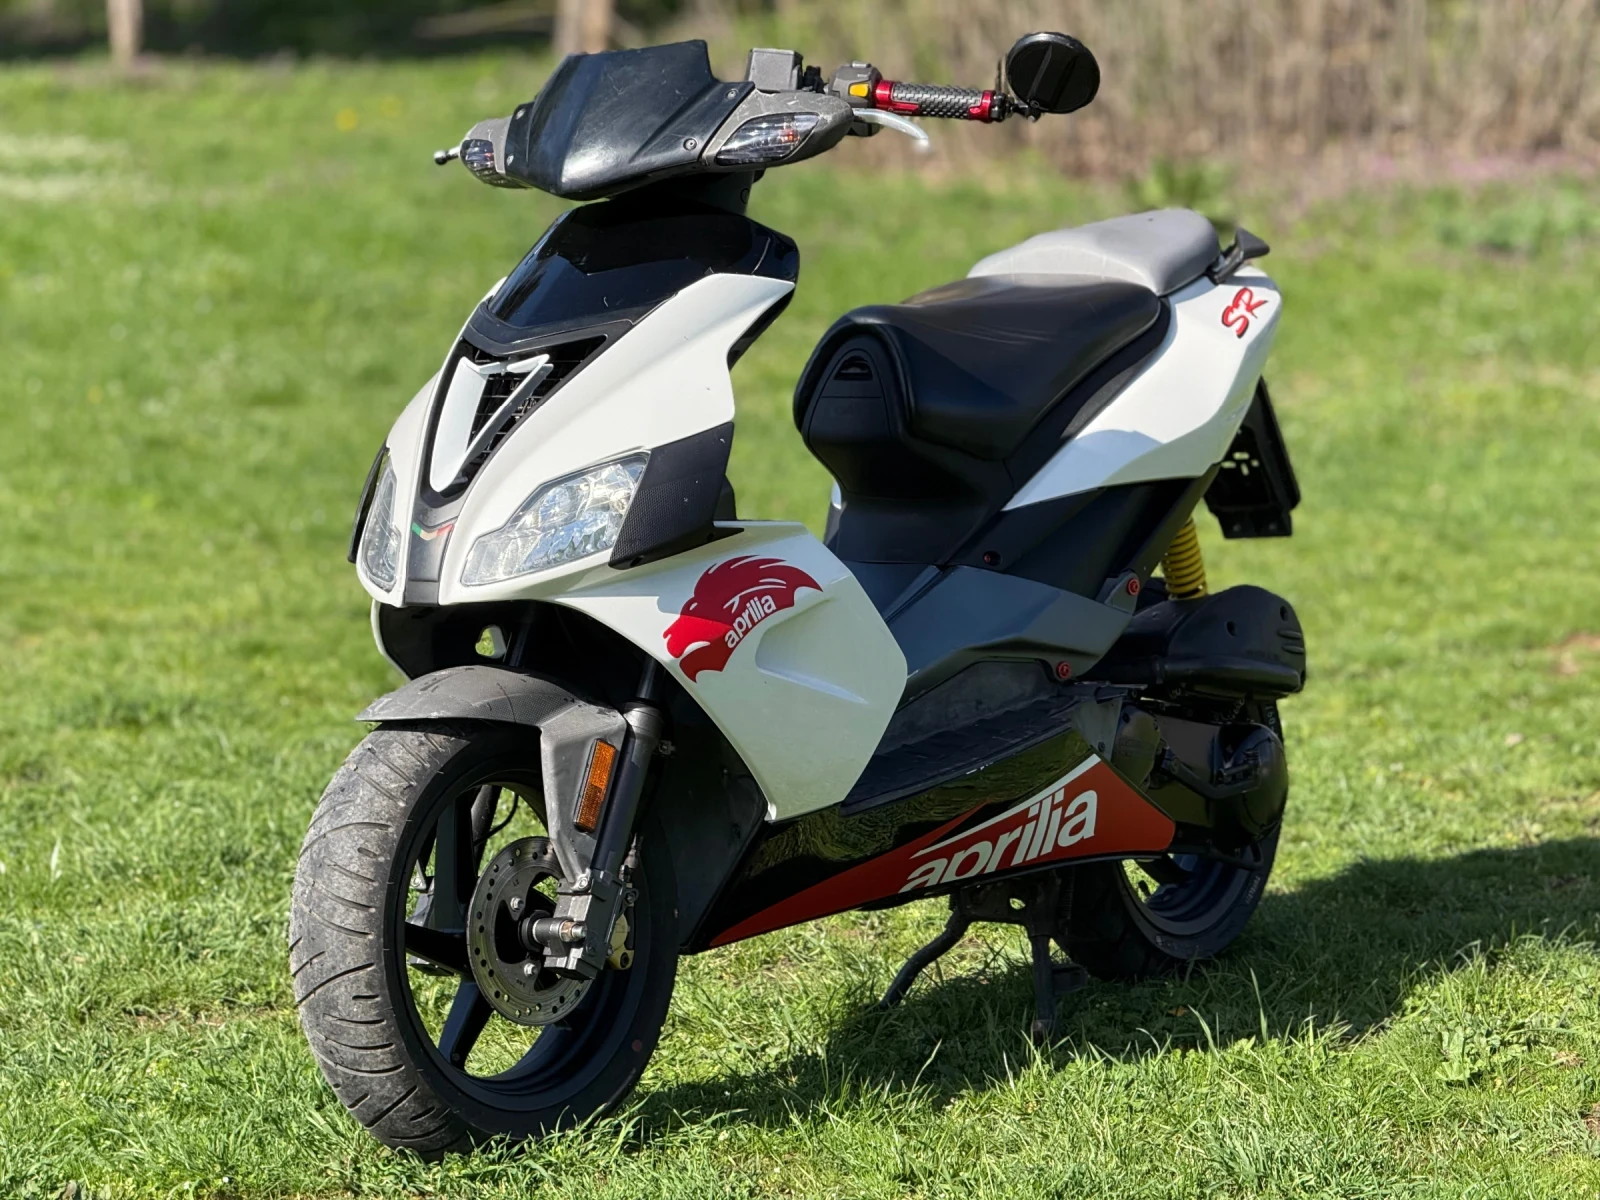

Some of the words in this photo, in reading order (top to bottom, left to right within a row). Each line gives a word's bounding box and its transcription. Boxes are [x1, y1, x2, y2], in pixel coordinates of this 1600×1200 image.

[1221, 287, 1268, 339] SR
[724, 594, 777, 648] aprilia
[898, 788, 1098, 894] aprilia
